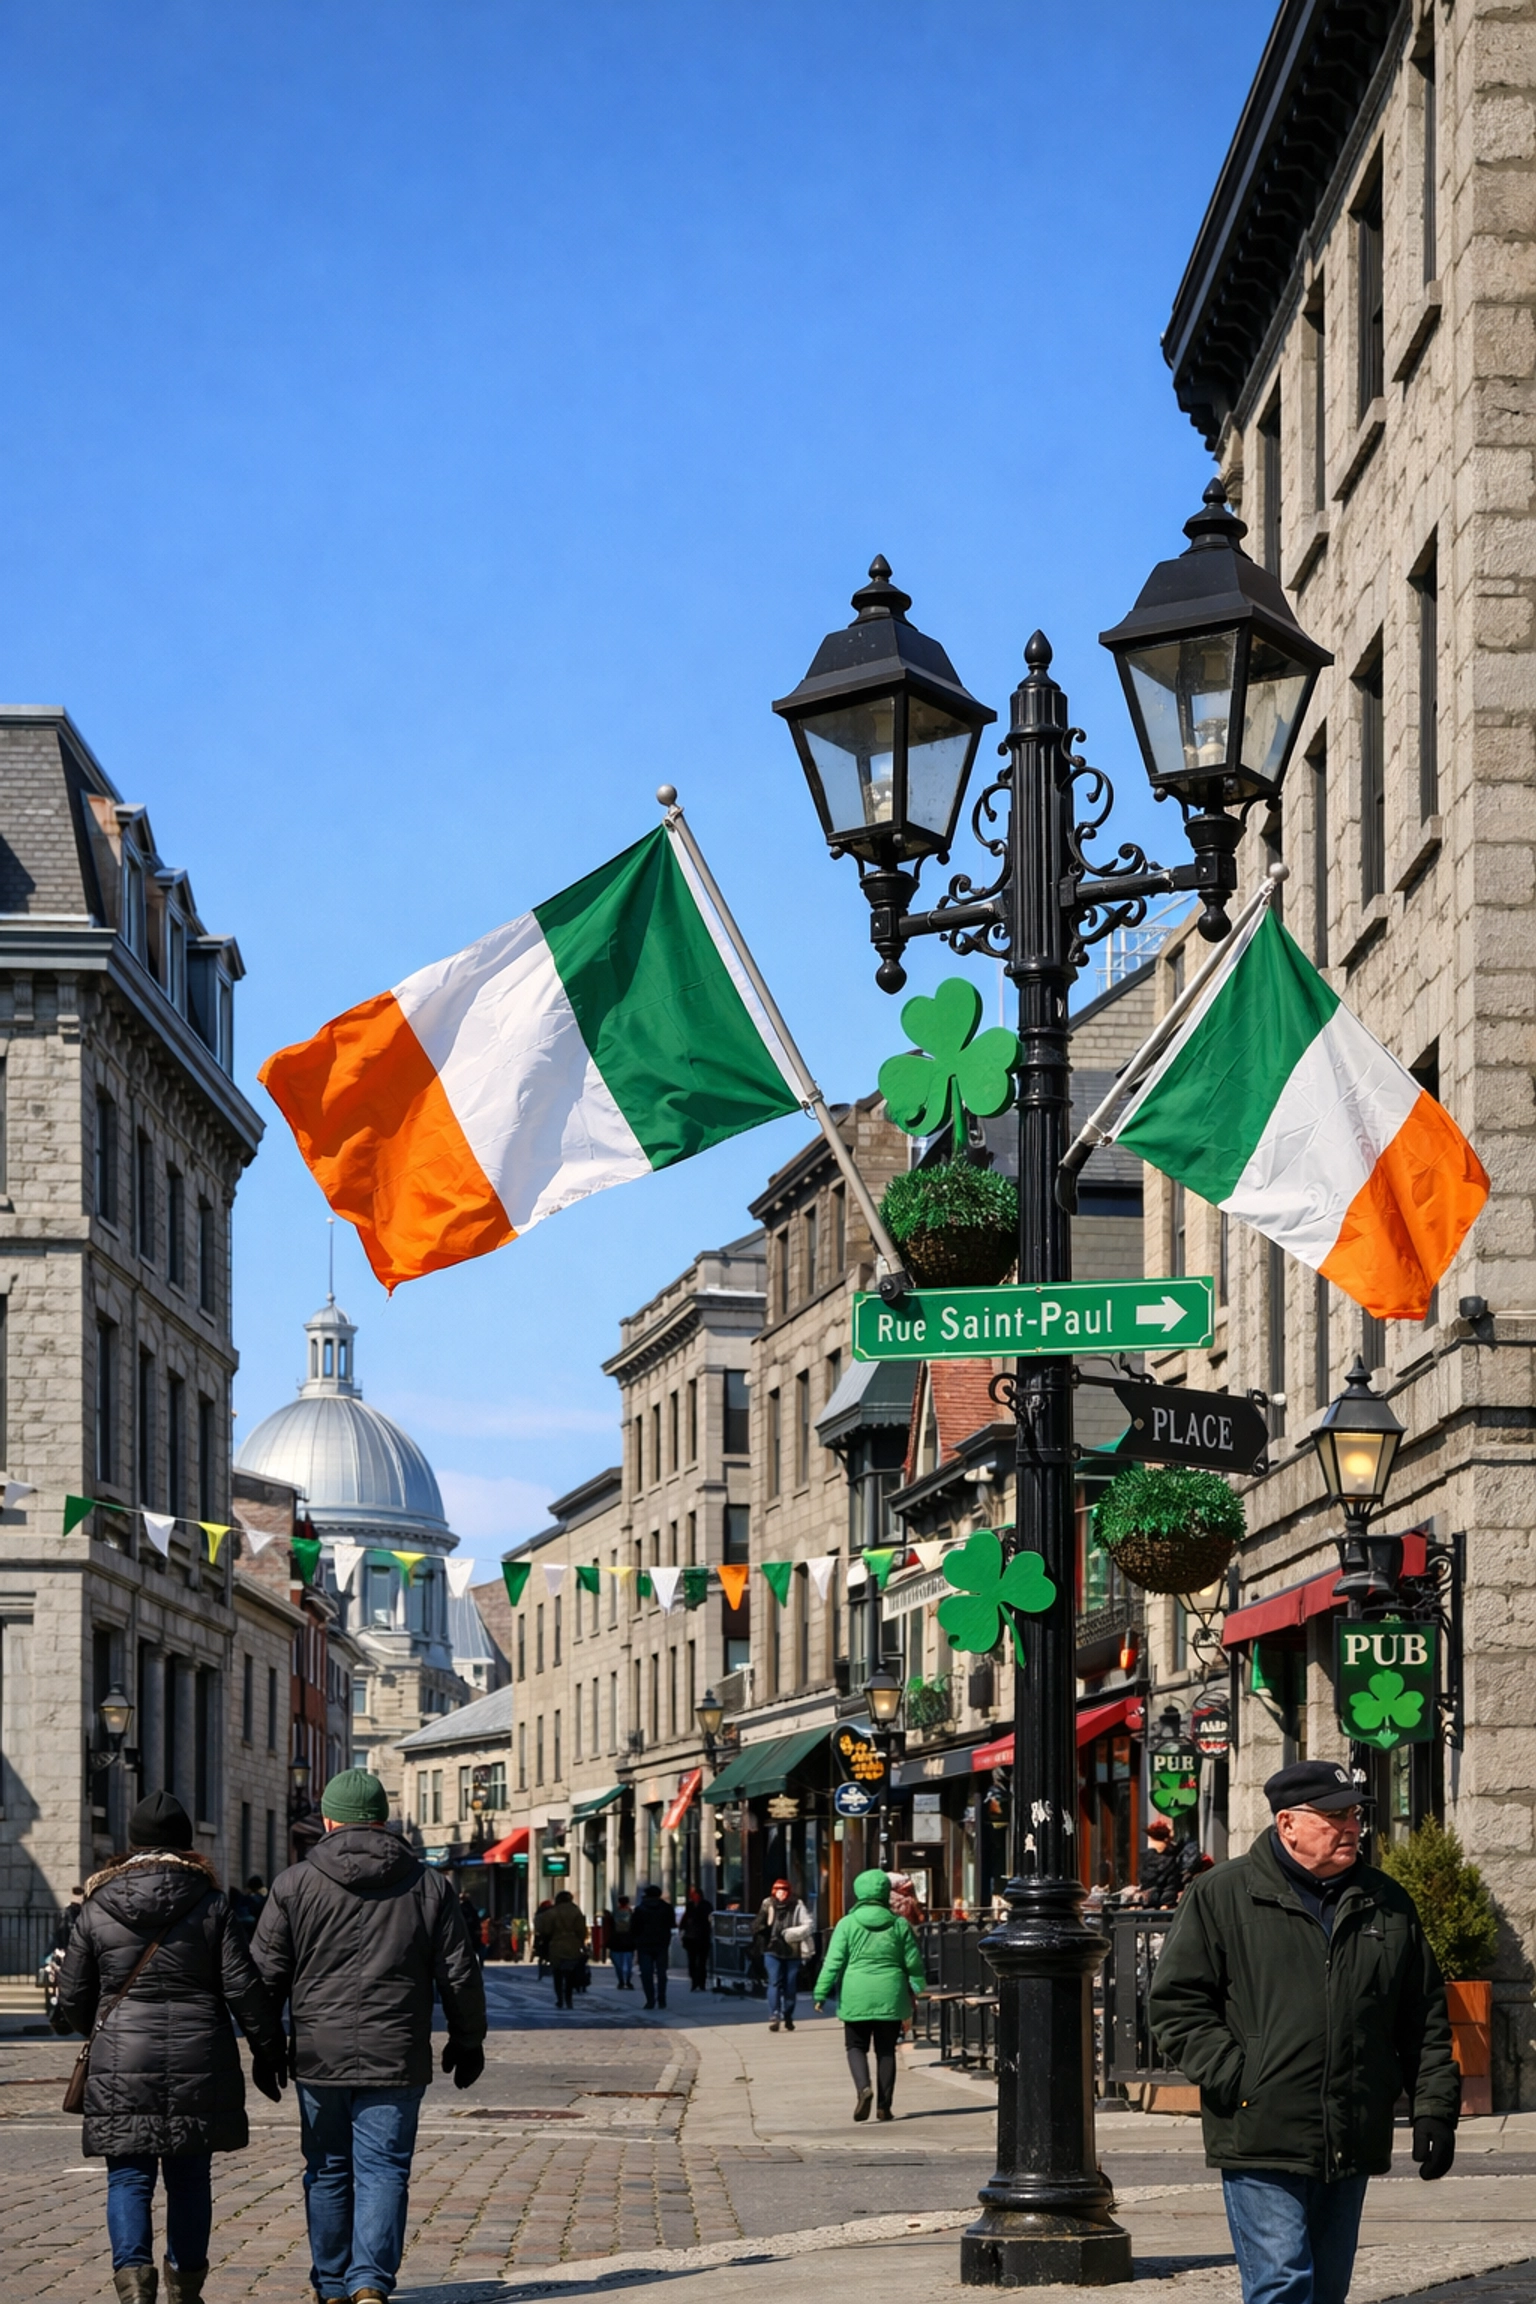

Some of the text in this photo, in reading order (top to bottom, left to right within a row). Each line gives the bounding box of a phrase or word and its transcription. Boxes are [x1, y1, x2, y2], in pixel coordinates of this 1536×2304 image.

[878, 1299, 1113, 1342] Rue Saint-Paul
[1152, 1407, 1234, 1451] PLACE
[1344, 1634, 1428, 1666] PUB
